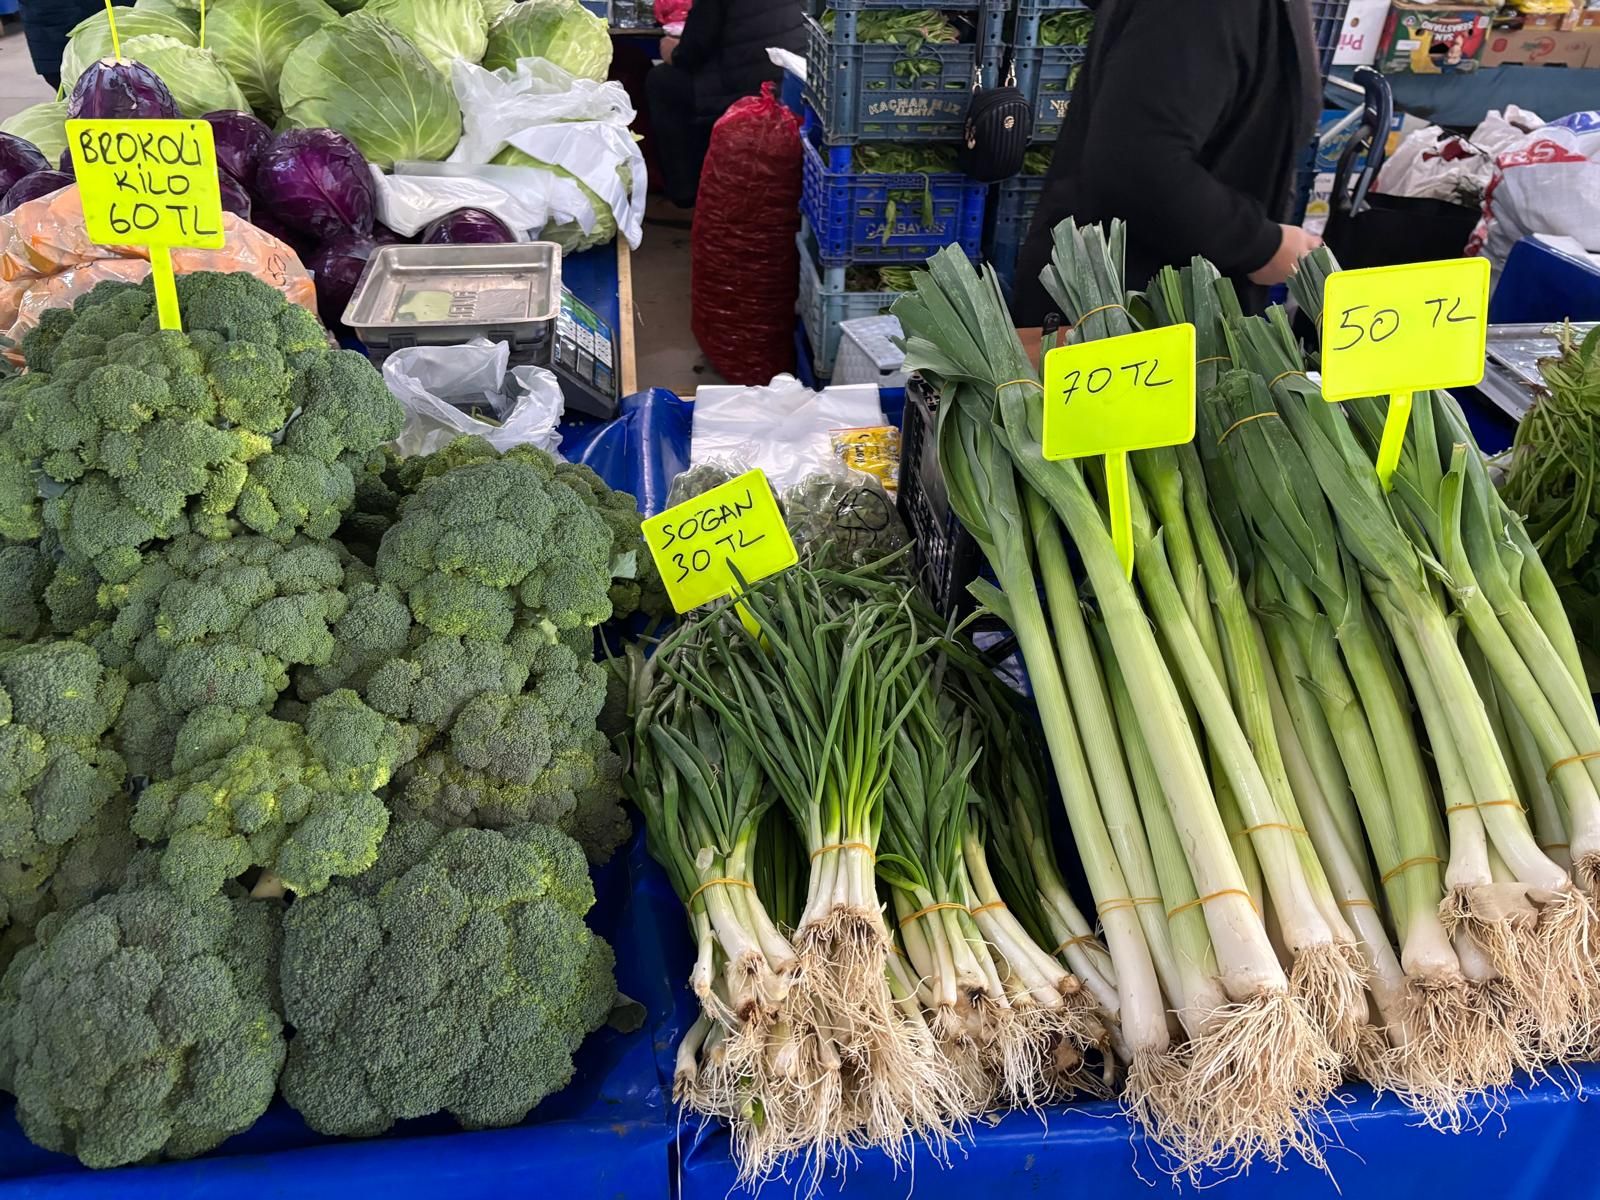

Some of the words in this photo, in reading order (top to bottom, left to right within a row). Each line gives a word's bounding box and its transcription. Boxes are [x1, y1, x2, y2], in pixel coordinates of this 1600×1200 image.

[109, 202, 160, 234] 60
[165, 204, 218, 235] TL
[1333, 304, 1400, 350] 50
[1425, 297, 1476, 328] TL
[1063, 367, 1112, 405] 70
[1120, 359, 1173, 387] TL
[672, 549, 711, 583] 30
[715, 529, 766, 553] TL
